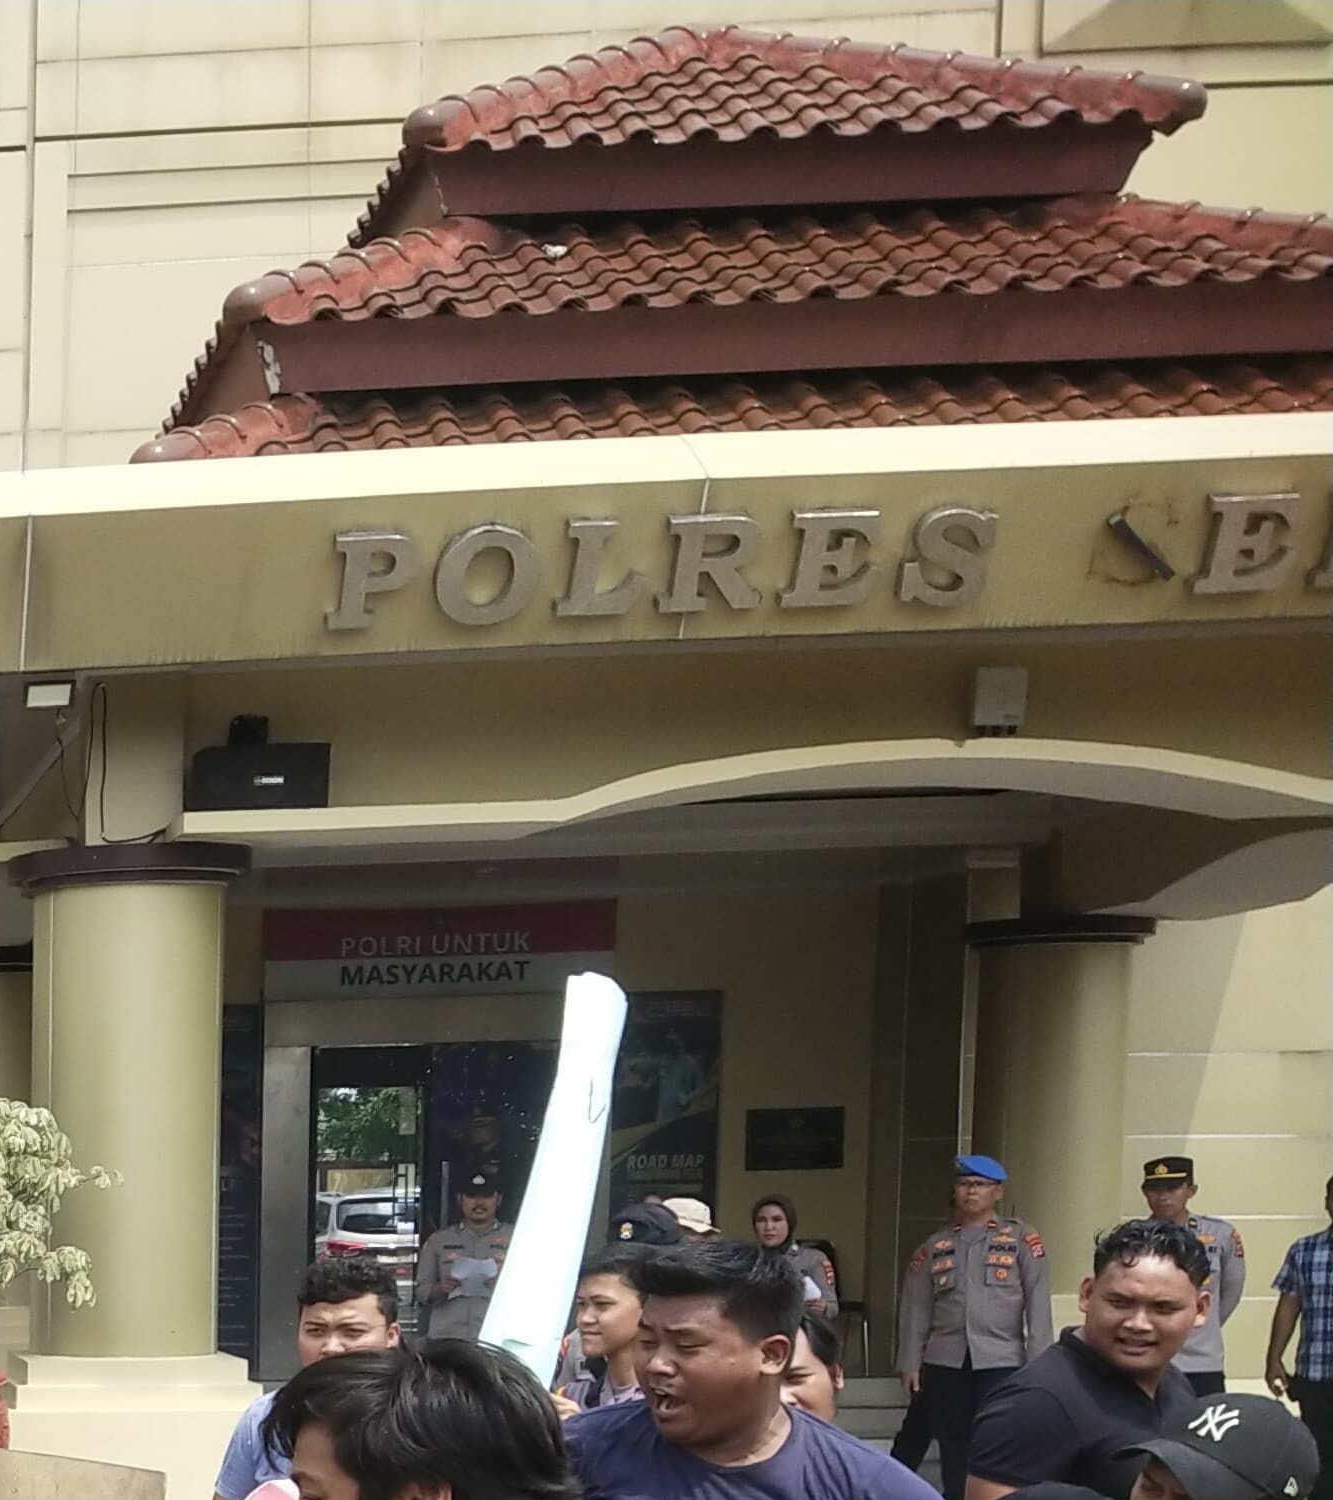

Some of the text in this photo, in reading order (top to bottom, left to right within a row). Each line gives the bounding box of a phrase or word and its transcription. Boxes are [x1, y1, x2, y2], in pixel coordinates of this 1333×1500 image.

[323, 506, 1000, 632] POLRES
[341, 931, 531, 957] POLRI UNTUK
[341, 960, 531, 986] MASYARAKAT
[628, 1153, 705, 1169] ROAD MAP
